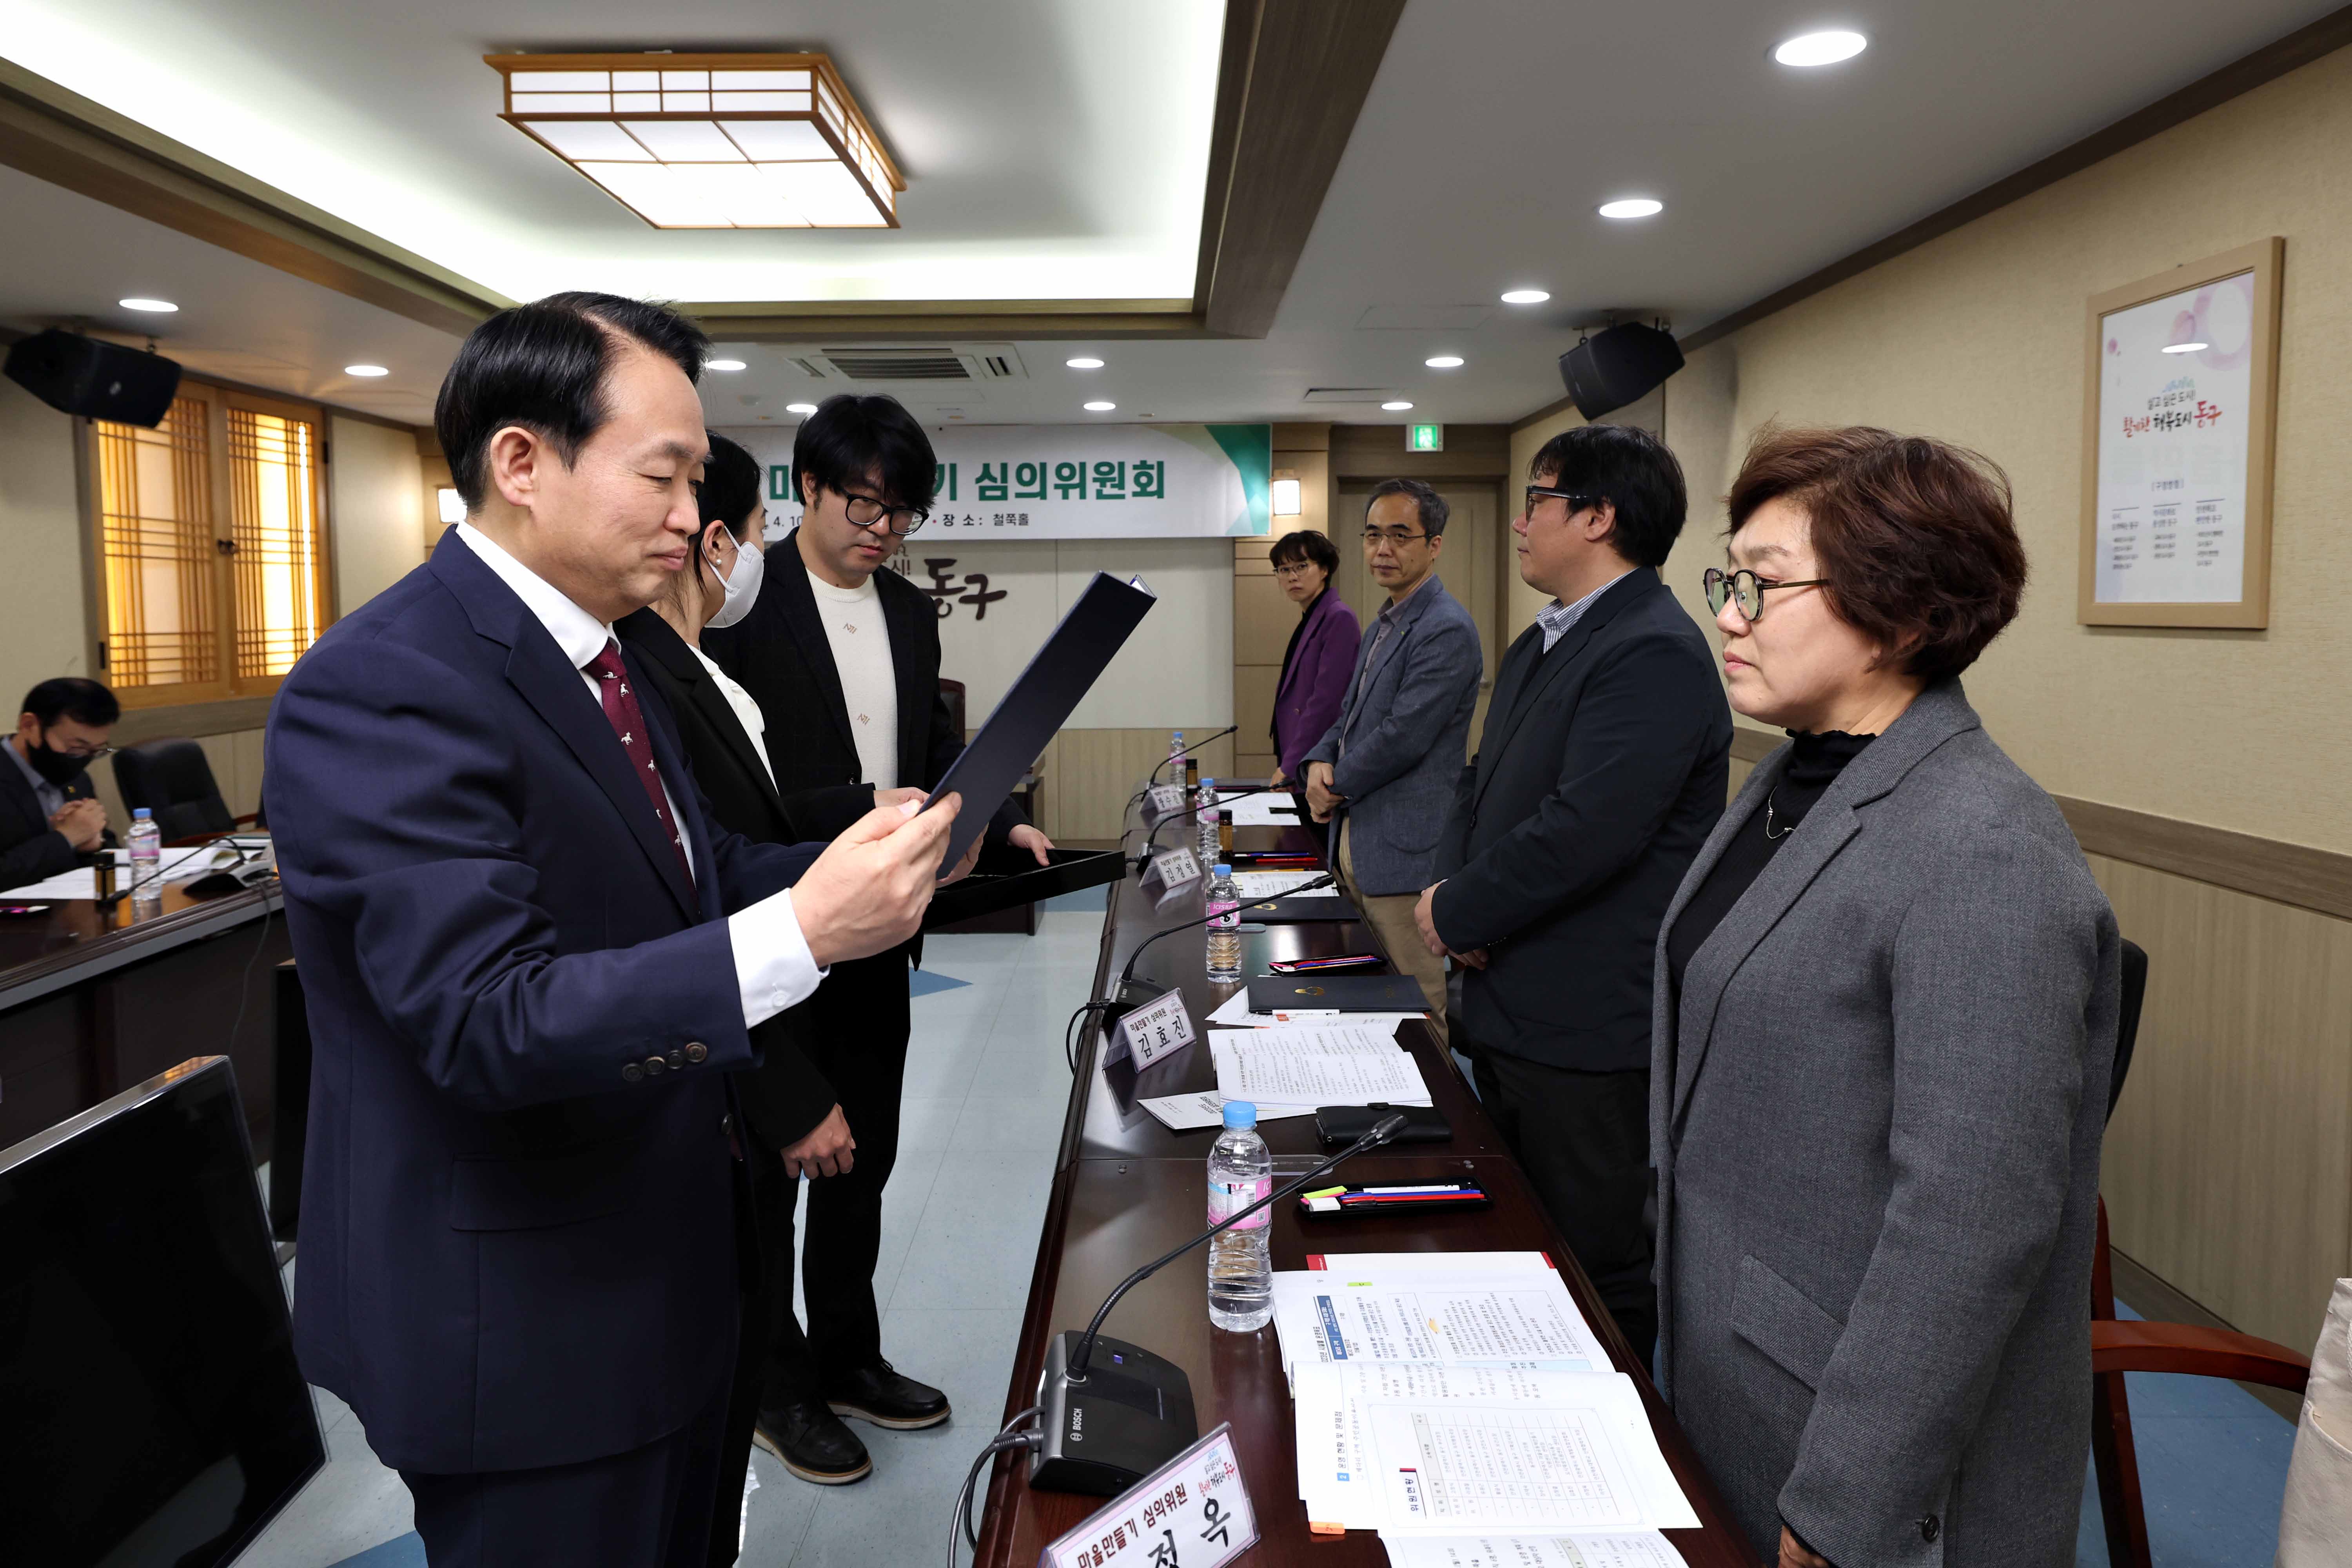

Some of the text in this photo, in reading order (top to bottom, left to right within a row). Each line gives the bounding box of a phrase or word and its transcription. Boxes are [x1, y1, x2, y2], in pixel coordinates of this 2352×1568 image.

[2194, 399, 2223, 428] 동구
[975, 460, 1165, 501] 심의위원회
[993, 513, 1029, 527] 철쭉홀
[917, 558, 1008, 621] 동구
[1073, 1408, 1082, 1430] BOSCH
[1334, 1411, 1343, 1430] 문제점
[1336, 1441, 1345, 1454] 현황
[1338, 1457, 1346, 1468] 운영
[1077, 1483, 1188, 1568] 마을만들기 심의위원
